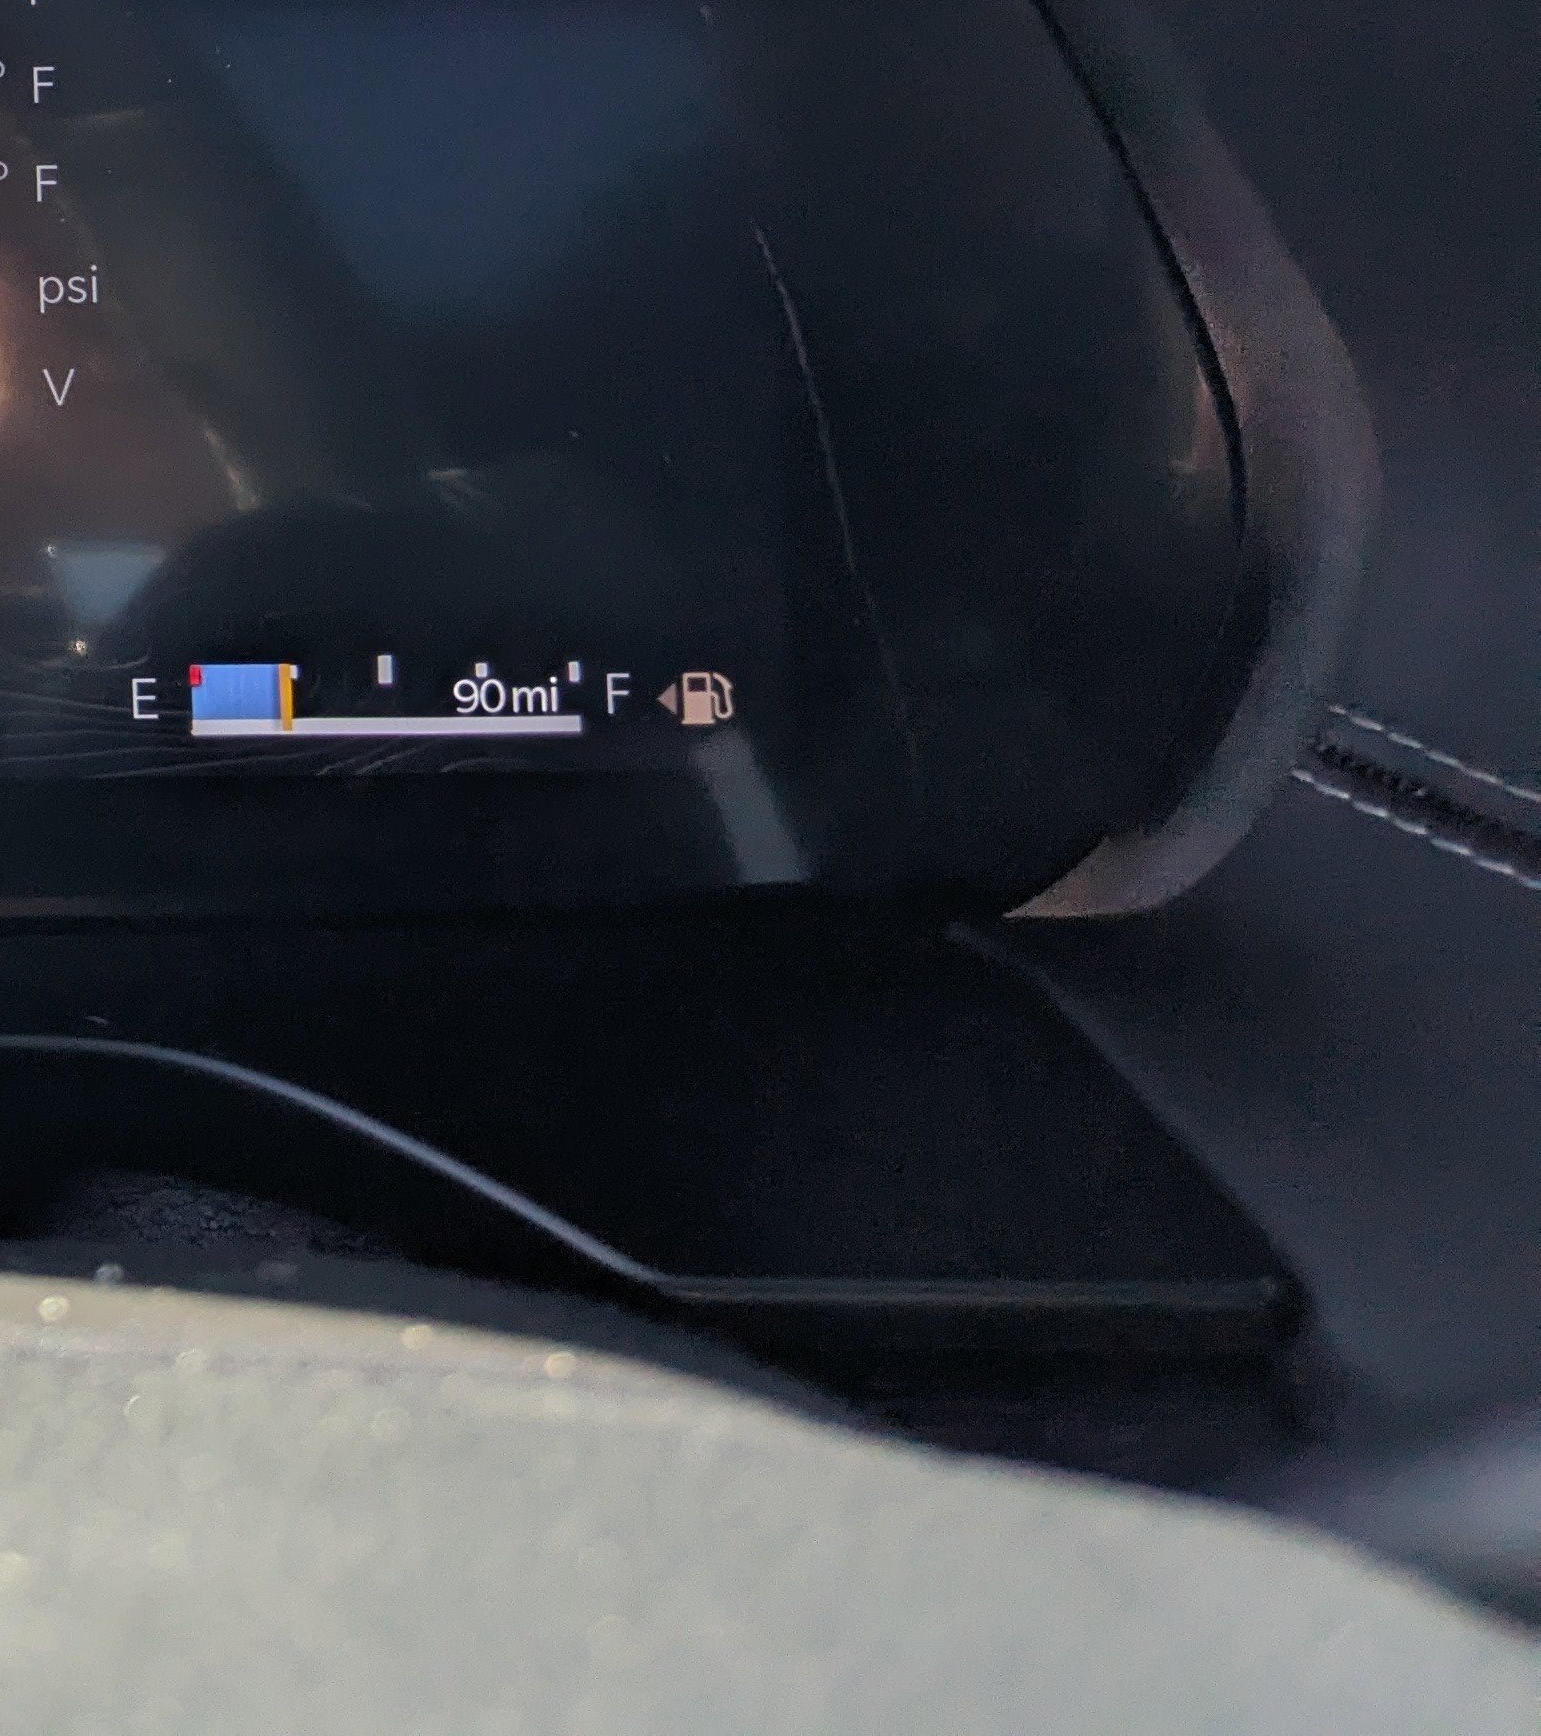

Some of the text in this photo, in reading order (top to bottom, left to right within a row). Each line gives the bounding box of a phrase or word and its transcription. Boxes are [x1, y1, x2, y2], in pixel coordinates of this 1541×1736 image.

[32, 66, 56, 104] F
[35, 165, 59, 203] F
[38, 265, 99, 314] psi
[44, 368, 75, 406] V
[131, 677, 159, 720] E
[606, 673, 630, 715] F
